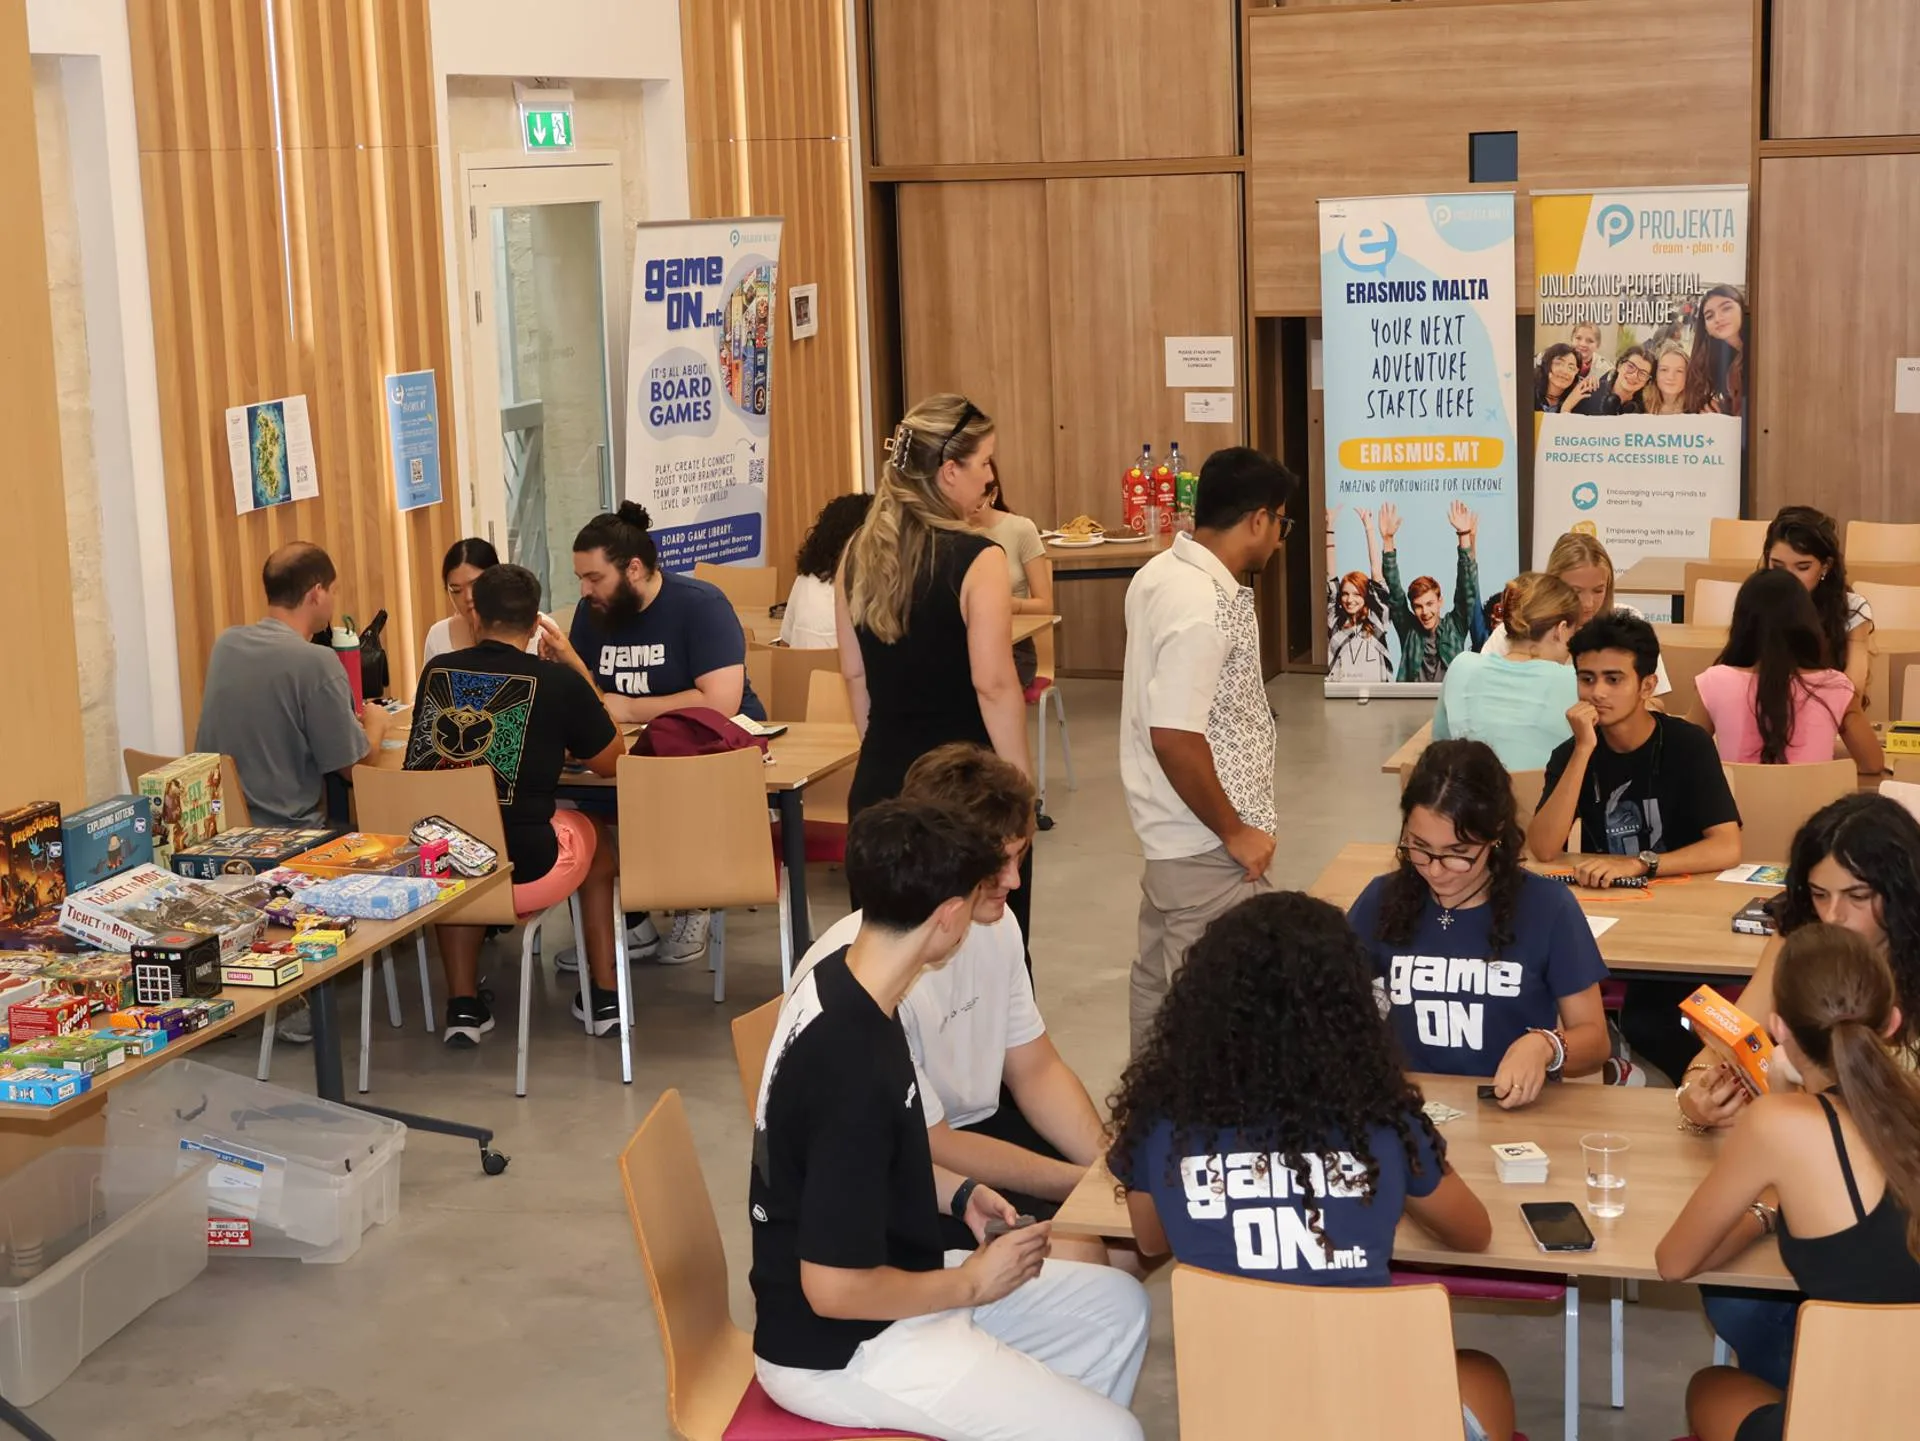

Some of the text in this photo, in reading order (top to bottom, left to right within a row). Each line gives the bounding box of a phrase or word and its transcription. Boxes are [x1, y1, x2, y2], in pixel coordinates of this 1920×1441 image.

[1640, 208, 1735, 240] PROJEKTA
[1652, 241, 1735, 256] dream plan do
[645, 256, 723, 302] game
[1346, 278, 1489, 304] ERASMUS MALTA
[1540, 273, 1622, 298] UNLOCKING
[667, 291, 723, 331] ON.mt
[1540, 300, 1673, 326] INSPIRING CHANGE
[1371, 314, 1466, 348] YOUR NEXT
[668, 366, 680, 378] ALL
[682, 363, 707, 377] ABOUT
[1372, 351, 1467, 383] ADVENTURE
[650, 376, 712, 403] BOARD
[649, 400, 712, 427] GAMES
[1367, 387, 1475, 420] STARTS HERE
[1360, 441, 1481, 464] ERASMUS.MT
[1554, 433, 1715, 448] ENGAGING ERASMUS+
[674, 459, 700, 472] CREATE
[1545, 452, 1726, 466] PROJECTS ACCESSIBLE TO ALL
[653, 487, 670, 500] TEAM
[672, 486, 680, 496] UP
[683, 484, 699, 495] WITH
[725, 477, 737, 487] AND
[655, 474, 676, 487] BOOST
[678, 472, 696, 484] YOUR
[1339, 477, 1503, 494] AMAZING OPPORTUNITIES FOR EVERYONE
[661, 499, 679, 511] LEVEL
[1606, 488, 1650, 497] Encouraging
[1652, 490, 1674, 498] young
[1631, 499, 1642, 507] big
[661, 532, 686, 546] BOARD
[687, 529, 708, 542] GAME
[1606, 527, 1649, 536] Empowering
[1650, 528, 1665, 536] with
[1685, 528, 1696, 536] for
[1637, 538, 1662, 546] growth
[663, 549, 682, 559] game,
[683, 546, 695, 554] and
[709, 541, 720, 549] into
[731, 534, 753, 545] Borrow
[694, 552, 719, 562] awesome
[599, 644, 665, 676] game
[114, 804, 135, 823] KITTENS
[84, 885, 131, 906] TICKET
[132, 870, 164, 886] RIDE
[67, 904, 101, 929] TICKET
[101, 922, 112, 931] TO
[112, 923, 136, 944] RIDE
[1390, 955, 1523, 1005] game
[1414, 1000, 1484, 1051] ON
[1180, 1151, 1370, 1220] game
[1232, 1206, 1368, 1270] ON.mt
